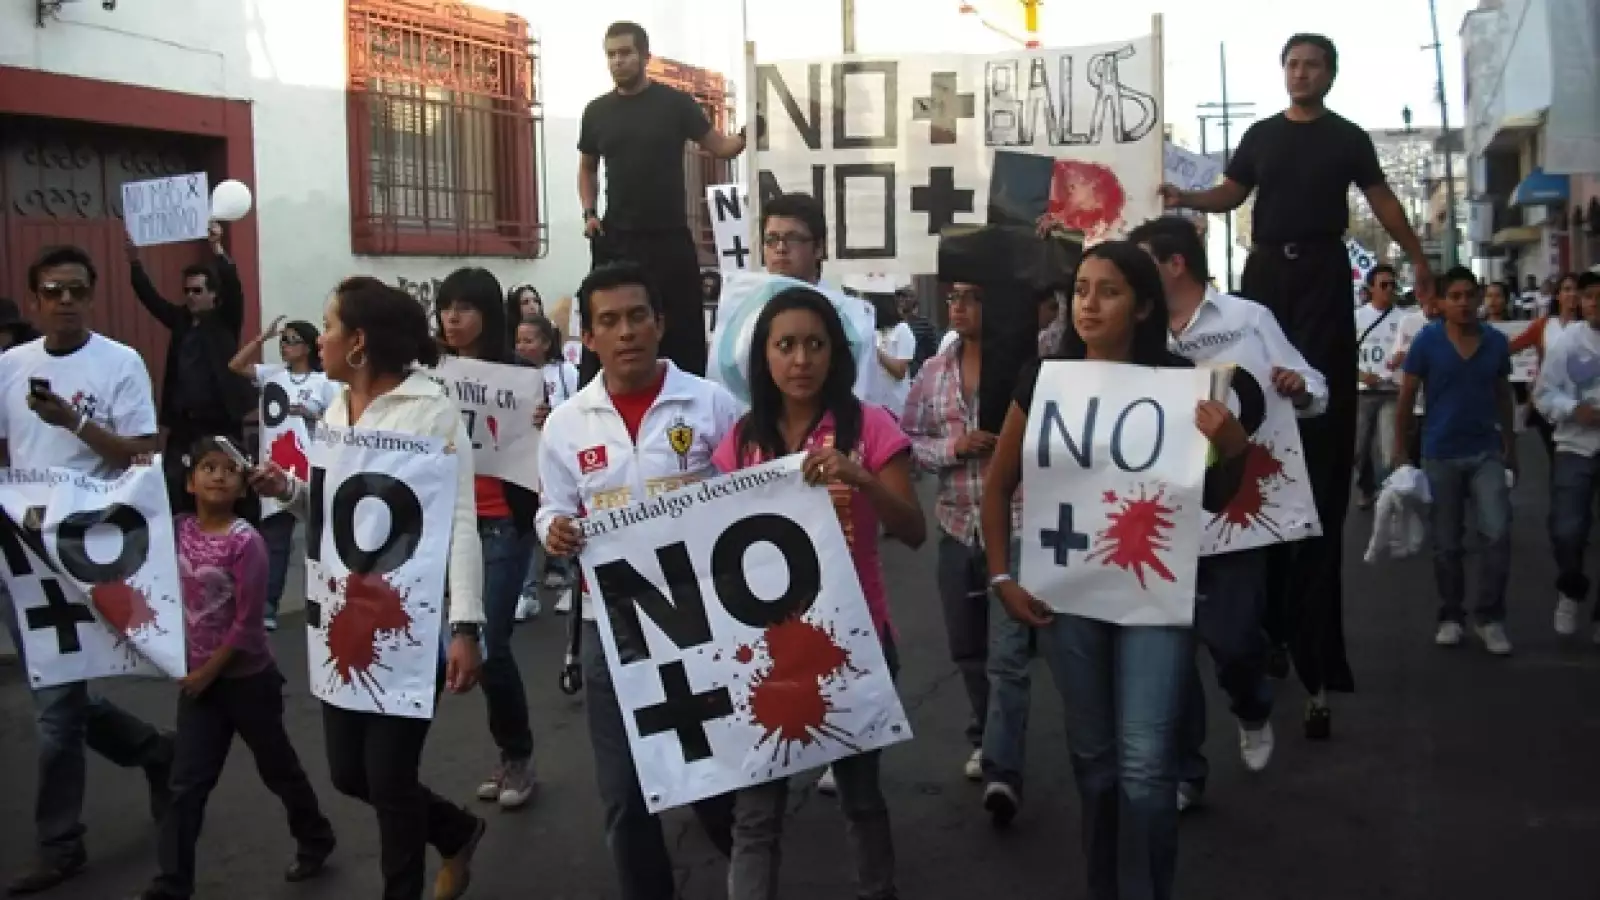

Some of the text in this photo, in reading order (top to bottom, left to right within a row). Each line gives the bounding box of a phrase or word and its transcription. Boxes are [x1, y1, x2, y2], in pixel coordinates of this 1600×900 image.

[756, 60, 898, 151] NO
[985, 44, 1158, 147] BALAS
[343, 427, 431, 454] decimos:
[1037, 396, 1165, 473] NO
[608, 494, 693, 530] Hidalgo
[697, 465, 788, 504] decimos:
[593, 512, 821, 666] NO
